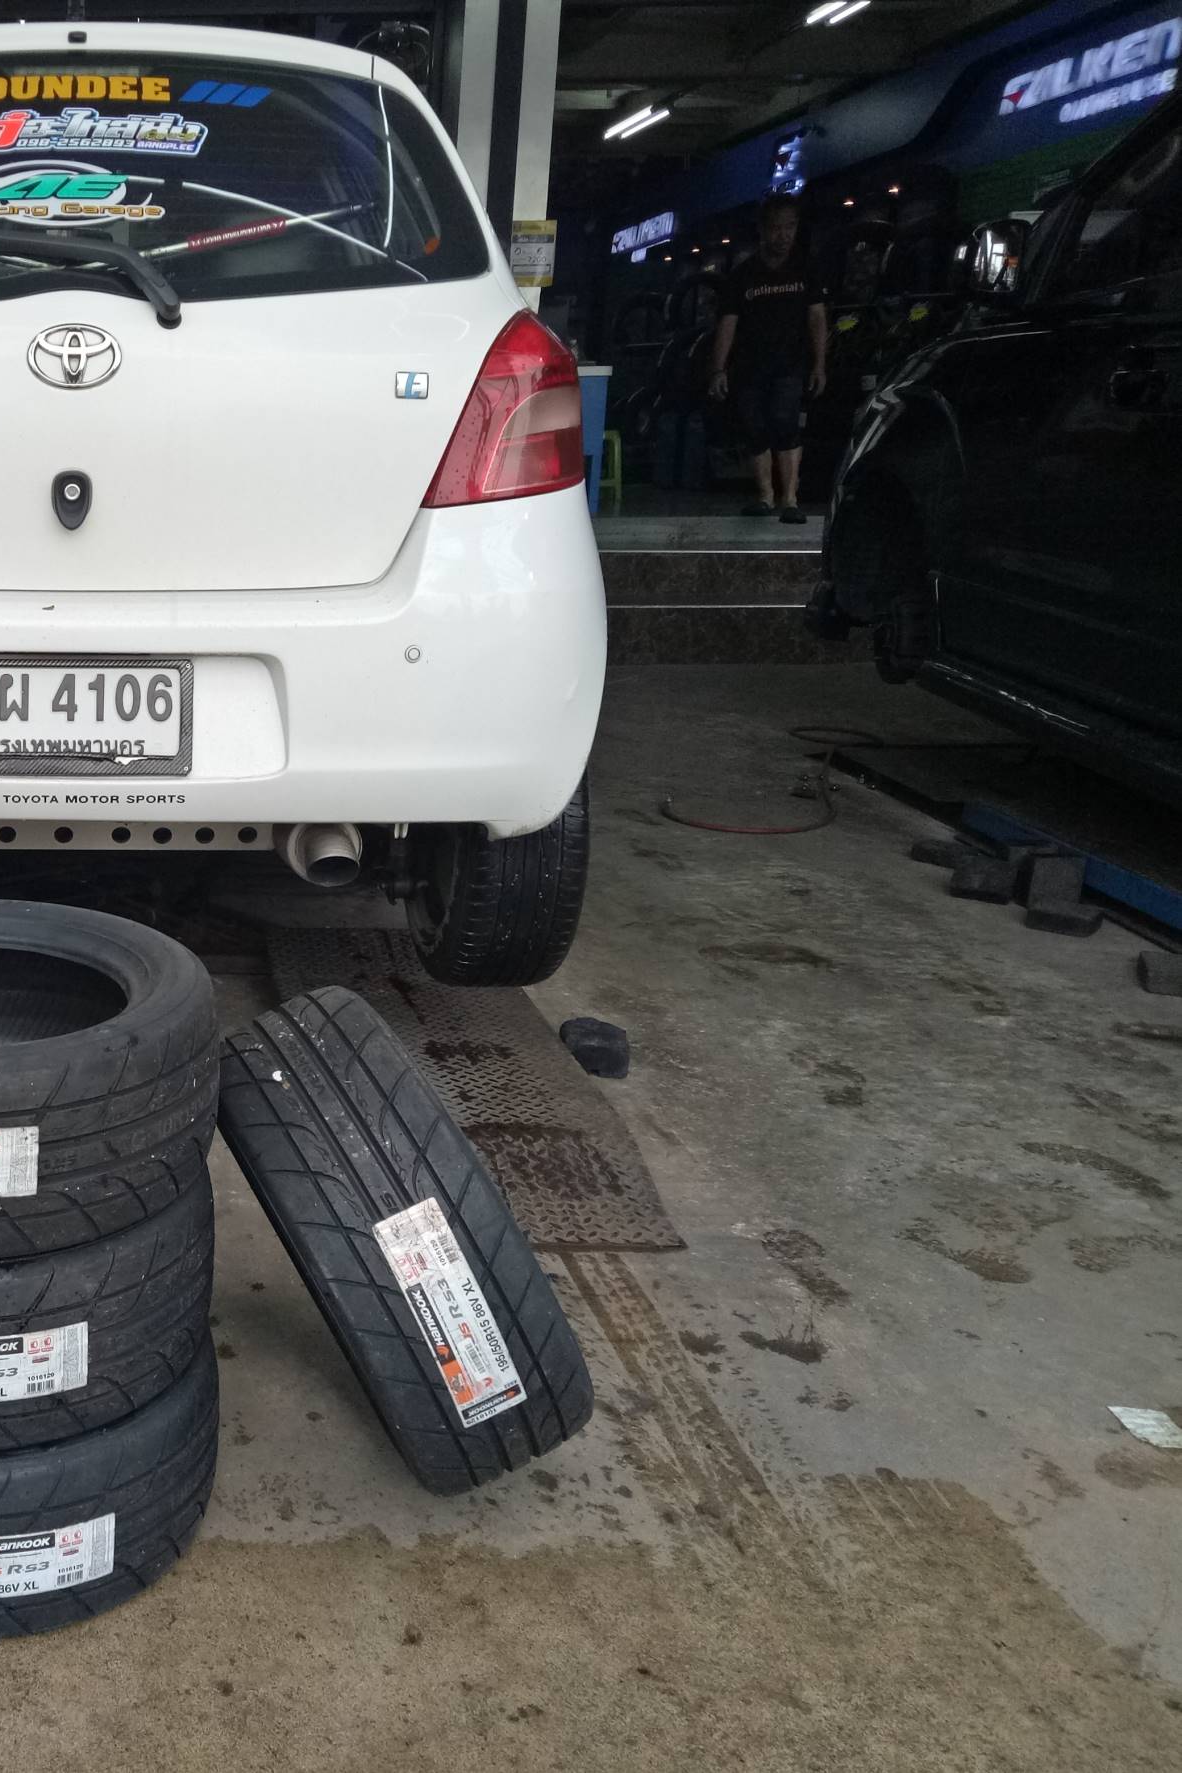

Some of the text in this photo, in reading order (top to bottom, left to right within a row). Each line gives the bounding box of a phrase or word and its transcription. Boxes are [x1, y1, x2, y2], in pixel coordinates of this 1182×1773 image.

[60, 202, 163, 217] Garage
[51, 673, 173, 722] 4106
[3, 795, 186, 804] TOYOTA MOTOR SPORTS
[460, 1277, 510, 1373] 195/50R15 86V XL
[23, 1581, 39, 1591] XL
